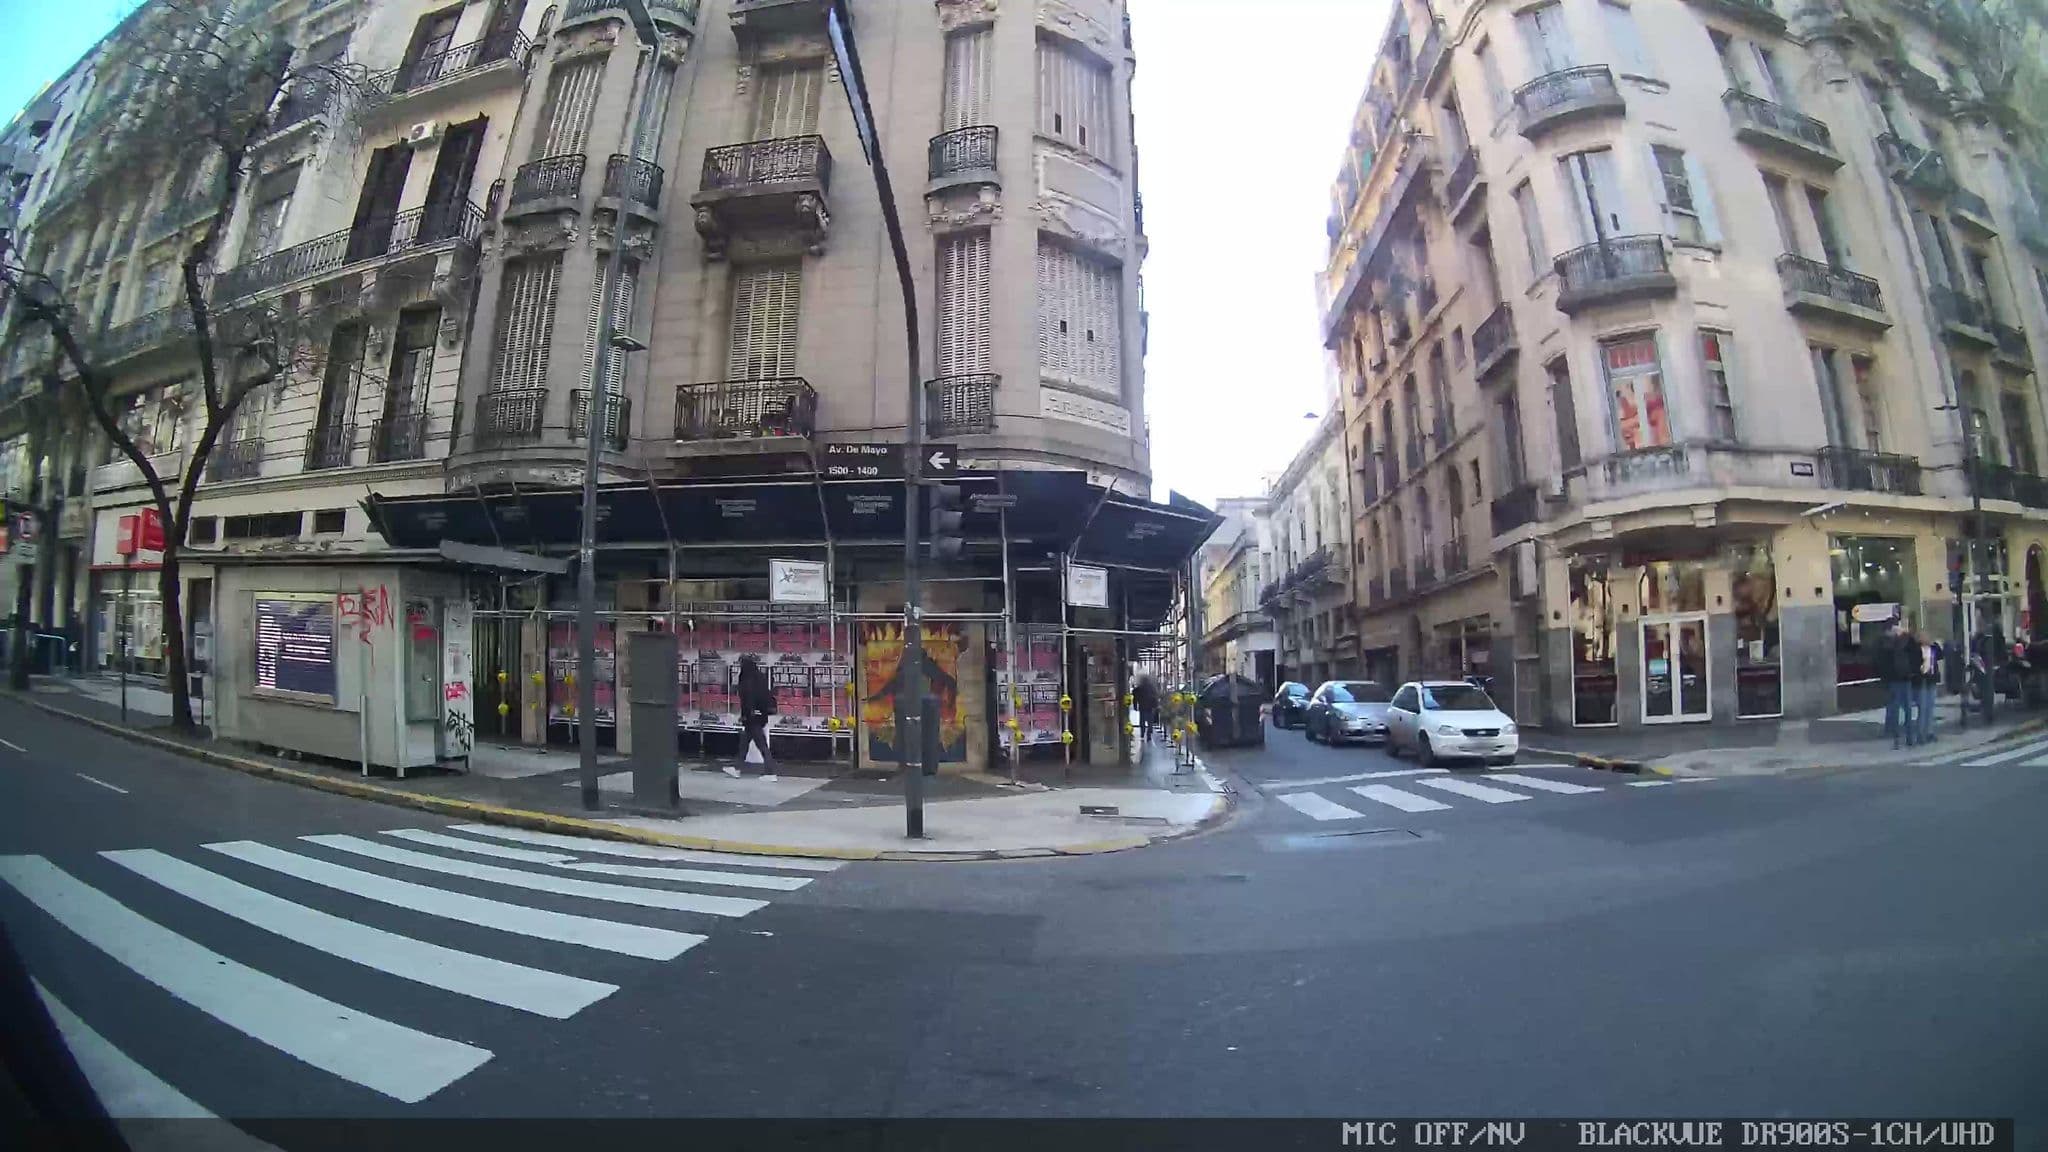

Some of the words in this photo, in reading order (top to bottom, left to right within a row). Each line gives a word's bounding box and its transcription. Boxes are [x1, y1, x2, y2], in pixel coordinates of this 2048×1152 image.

[828, 445, 844, 454] Av.
[846, 445, 859, 454] De
[860, 445, 888, 456] Mayo
[828, 466, 849, 475] 1500
[857, 466, 878, 475] 1400
